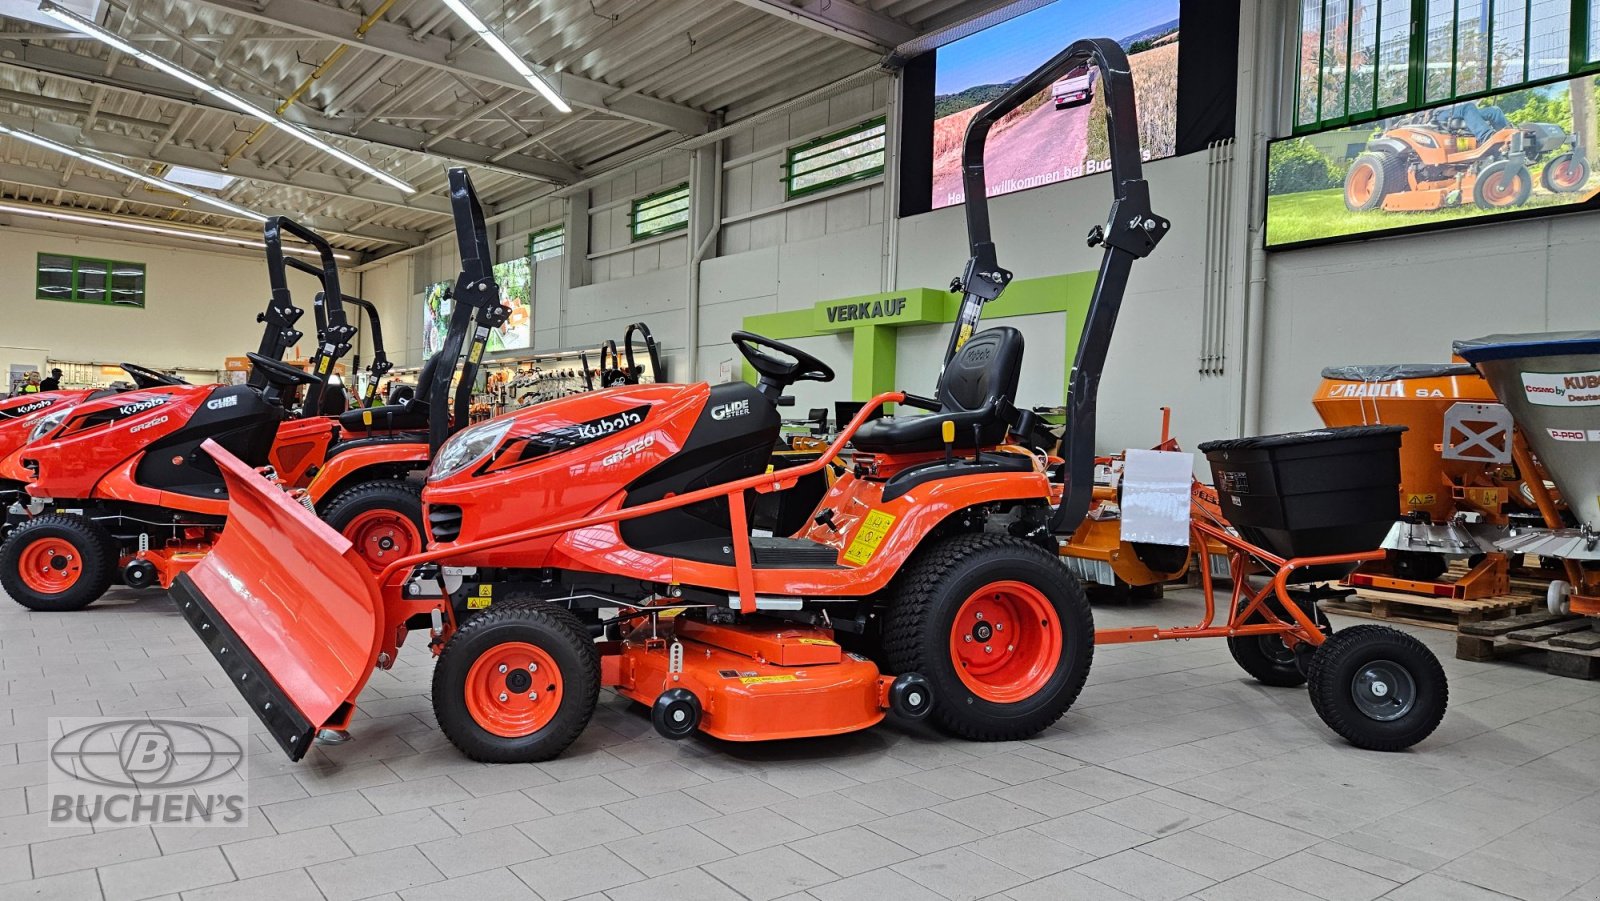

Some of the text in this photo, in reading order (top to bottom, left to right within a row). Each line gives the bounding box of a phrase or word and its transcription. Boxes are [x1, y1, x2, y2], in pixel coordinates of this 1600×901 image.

[991, 169, 1059, 195] willkommen
[1063, 160, 1083, 178] bei
[827, 298, 906, 323] VERKAUF
[1564, 375, 1600, 389] KUB
[1344, 383, 1405, 397] RAUCH
[1415, 389, 1444, 397] SA
[1555, 386, 1565, 396] by
[17, 400, 51, 413] Kubota
[120, 398, 164, 415] Kubota
[207, 395, 238, 410] GLIDE
[711, 399, 749, 420] GLIDE
[726, 408, 750, 418] STEER
[130, 416, 168, 433] GR2120
[578, 412, 641, 438] Kubota
[1552, 431, 1583, 439] P-PRO
[602, 436, 655, 467] GR2120
